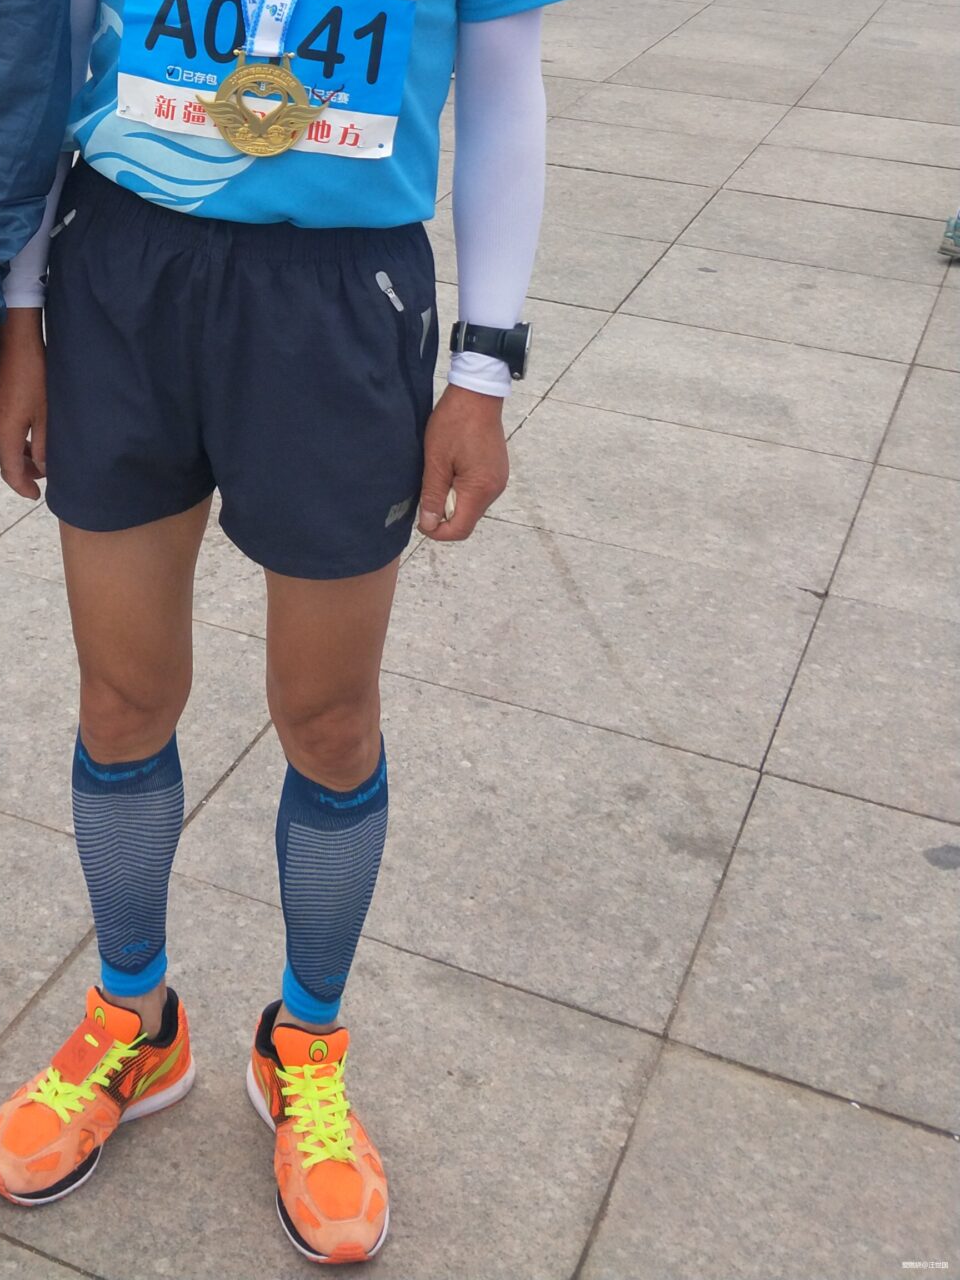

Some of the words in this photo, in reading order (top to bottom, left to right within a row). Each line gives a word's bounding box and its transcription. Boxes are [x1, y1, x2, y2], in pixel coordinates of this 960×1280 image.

[182, 70, 217, 86] 已存包
[154, 94, 364, 148] 新疆地方
